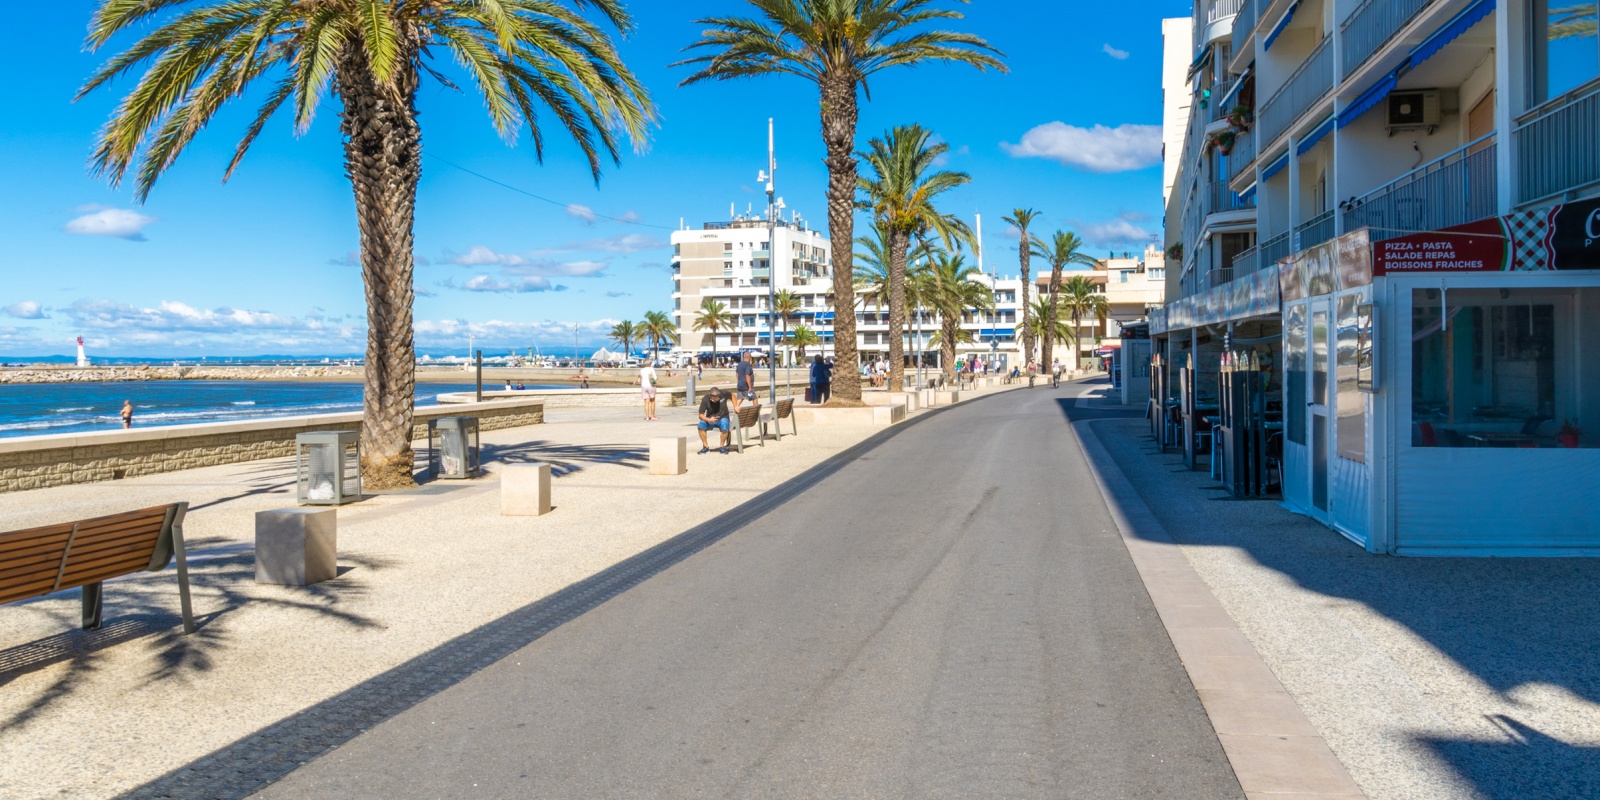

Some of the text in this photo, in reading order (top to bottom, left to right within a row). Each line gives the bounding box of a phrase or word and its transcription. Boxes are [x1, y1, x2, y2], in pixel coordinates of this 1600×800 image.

[1385, 242, 1452, 250] PIZZA PASTA
[1385, 251, 1455, 260] SALADE REPAS
[1385, 260, 1483, 269] BOISSONS FRAICHES
